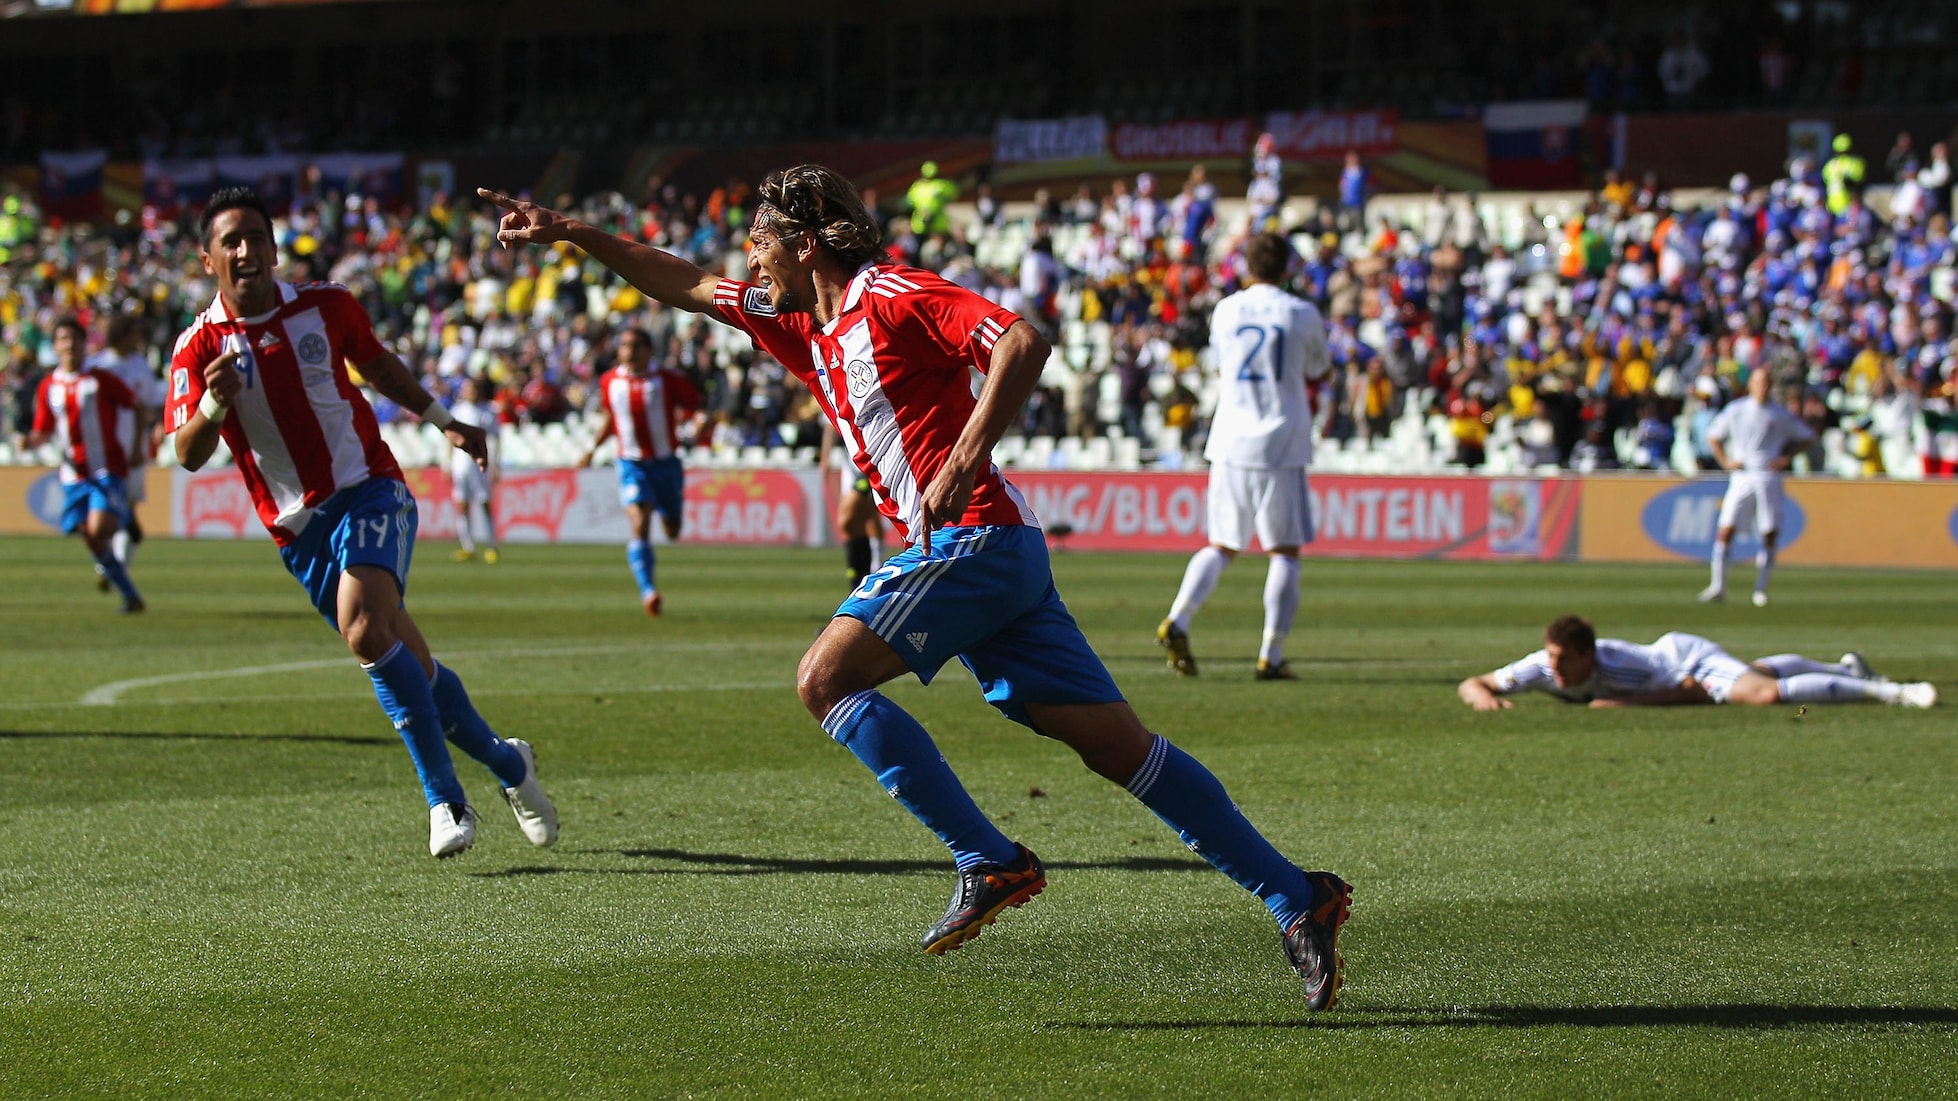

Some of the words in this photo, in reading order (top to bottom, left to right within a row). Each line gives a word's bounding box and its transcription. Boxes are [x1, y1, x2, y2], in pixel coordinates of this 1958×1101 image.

[1236, 324, 1285, 381] 21
[356, 513, 389, 549] 19
[680, 499, 798, 541] SEARA
